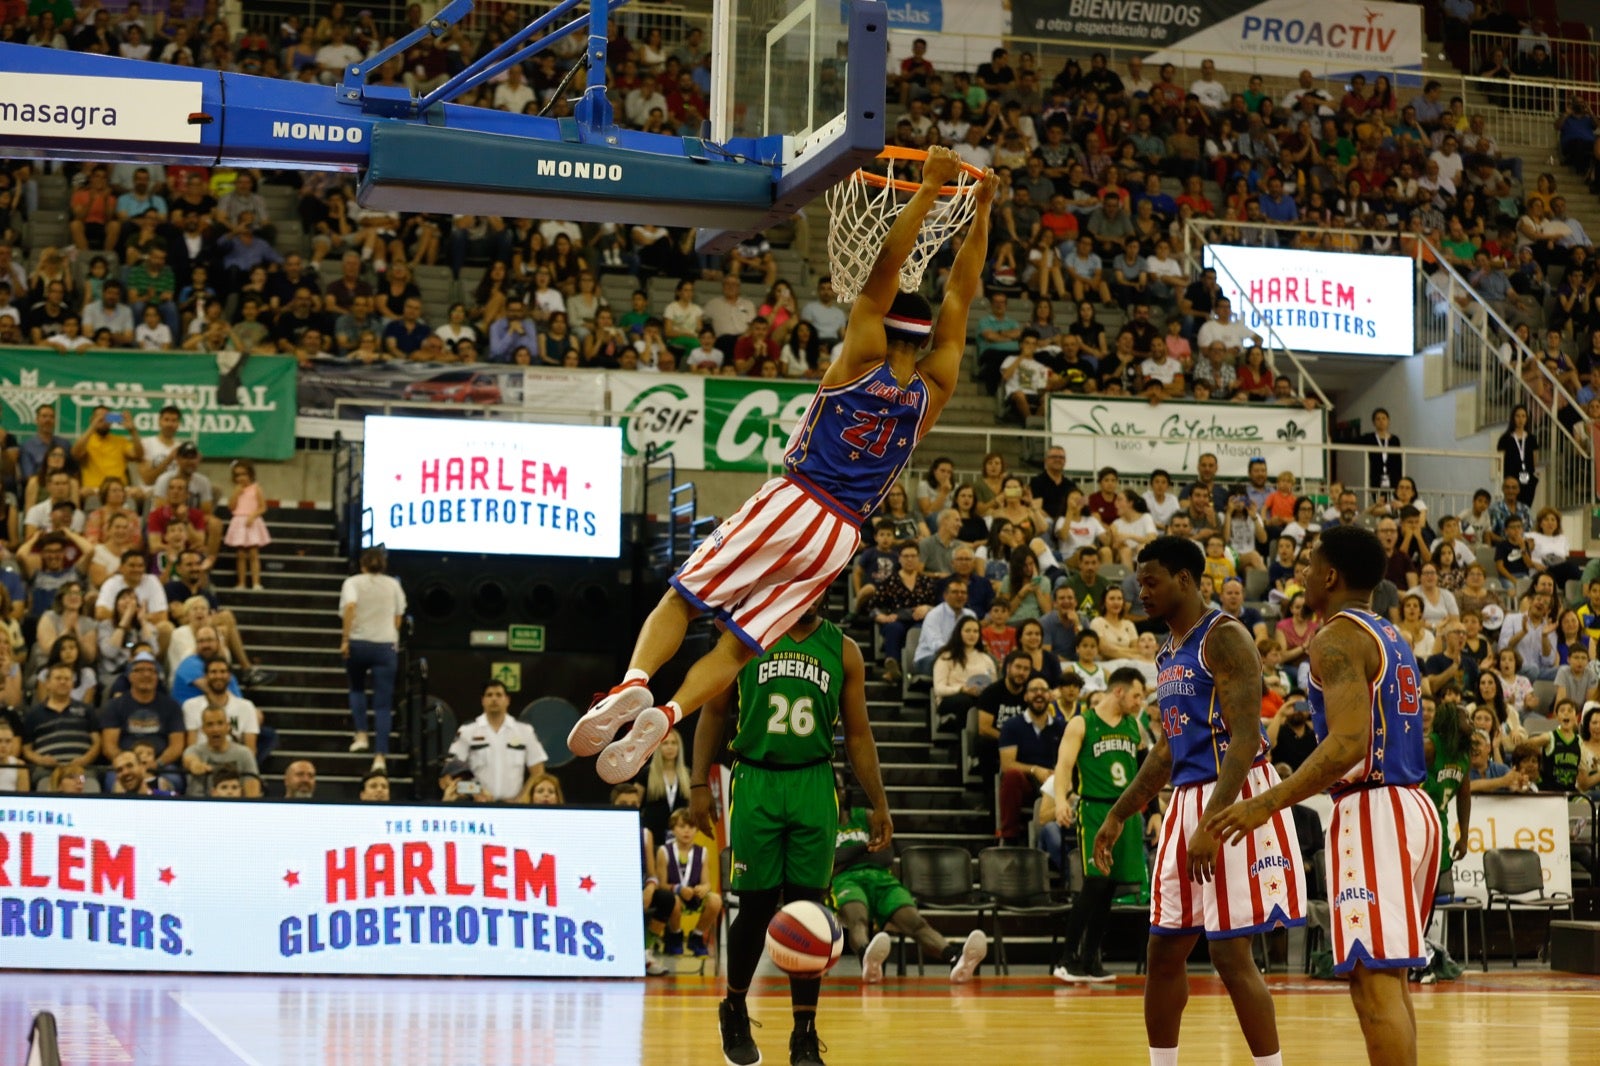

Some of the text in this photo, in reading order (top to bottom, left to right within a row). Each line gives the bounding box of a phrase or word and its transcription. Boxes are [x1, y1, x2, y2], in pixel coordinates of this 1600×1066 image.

[1069, 0, 1202, 27] BIENVENIDOS
[1036, 18, 1045, 30] a
[1047, 19, 1073, 32] otro
[1151, 26, 1167, 39] de
[1241, 16, 1396, 53] PROACTIV
[272, 121, 363, 143] MONDO
[537, 159, 623, 182] MONDO
[1250, 277, 1355, 311] HARLEM
[71, 381, 152, 409] CAJA
[634, 406, 698, 434] CSIF
[840, 410, 898, 458] 21
[421, 456, 567, 500] HARLEM
[390, 498, 596, 536] GLOBETROTTERS
[773, 652, 819, 666] WASHINGTON
[758, 660, 830, 694] GENERALS
[767, 693, 816, 737] 26
[1110, 761, 1127, 787] 9
[386, 820, 495, 837] THE ORIGINAL
[325, 841, 557, 907] HARLEM
[1251, 855, 1292, 878] HARLEM
[1334, 887, 1376, 910] HARLEM
